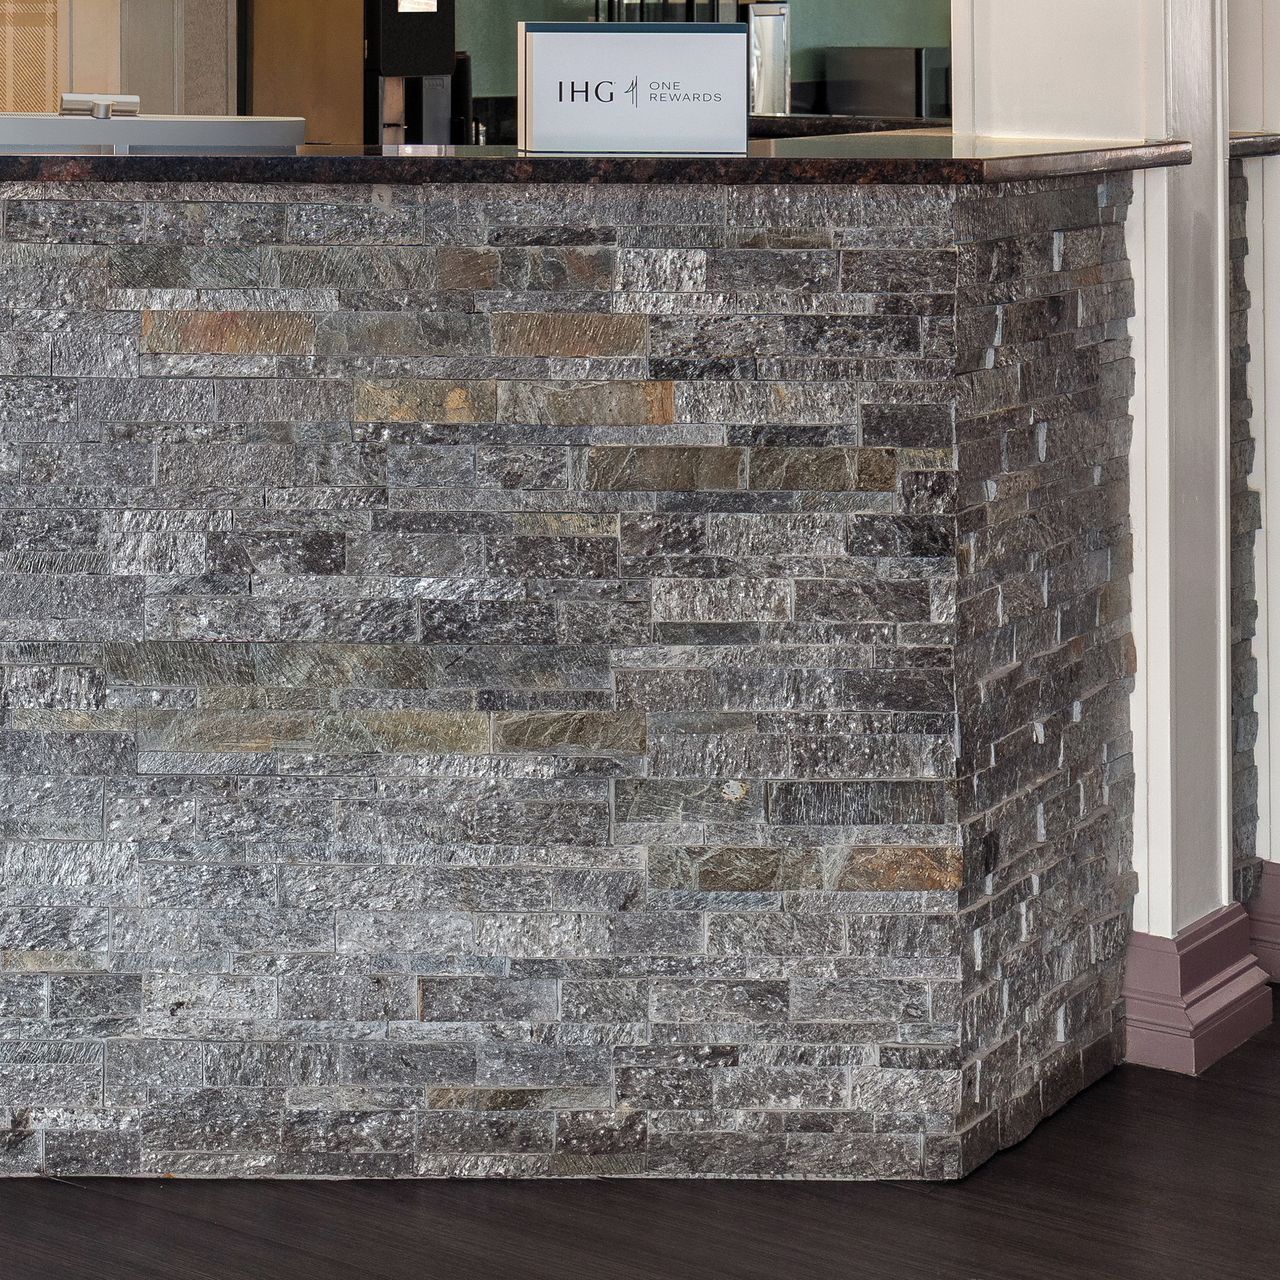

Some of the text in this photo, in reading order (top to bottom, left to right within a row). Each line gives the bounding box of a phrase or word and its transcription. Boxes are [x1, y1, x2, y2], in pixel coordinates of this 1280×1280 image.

[649, 81, 681, 91] ONE
[558, 80, 614, 103] IHG
[649, 93, 722, 102] REWARDS
